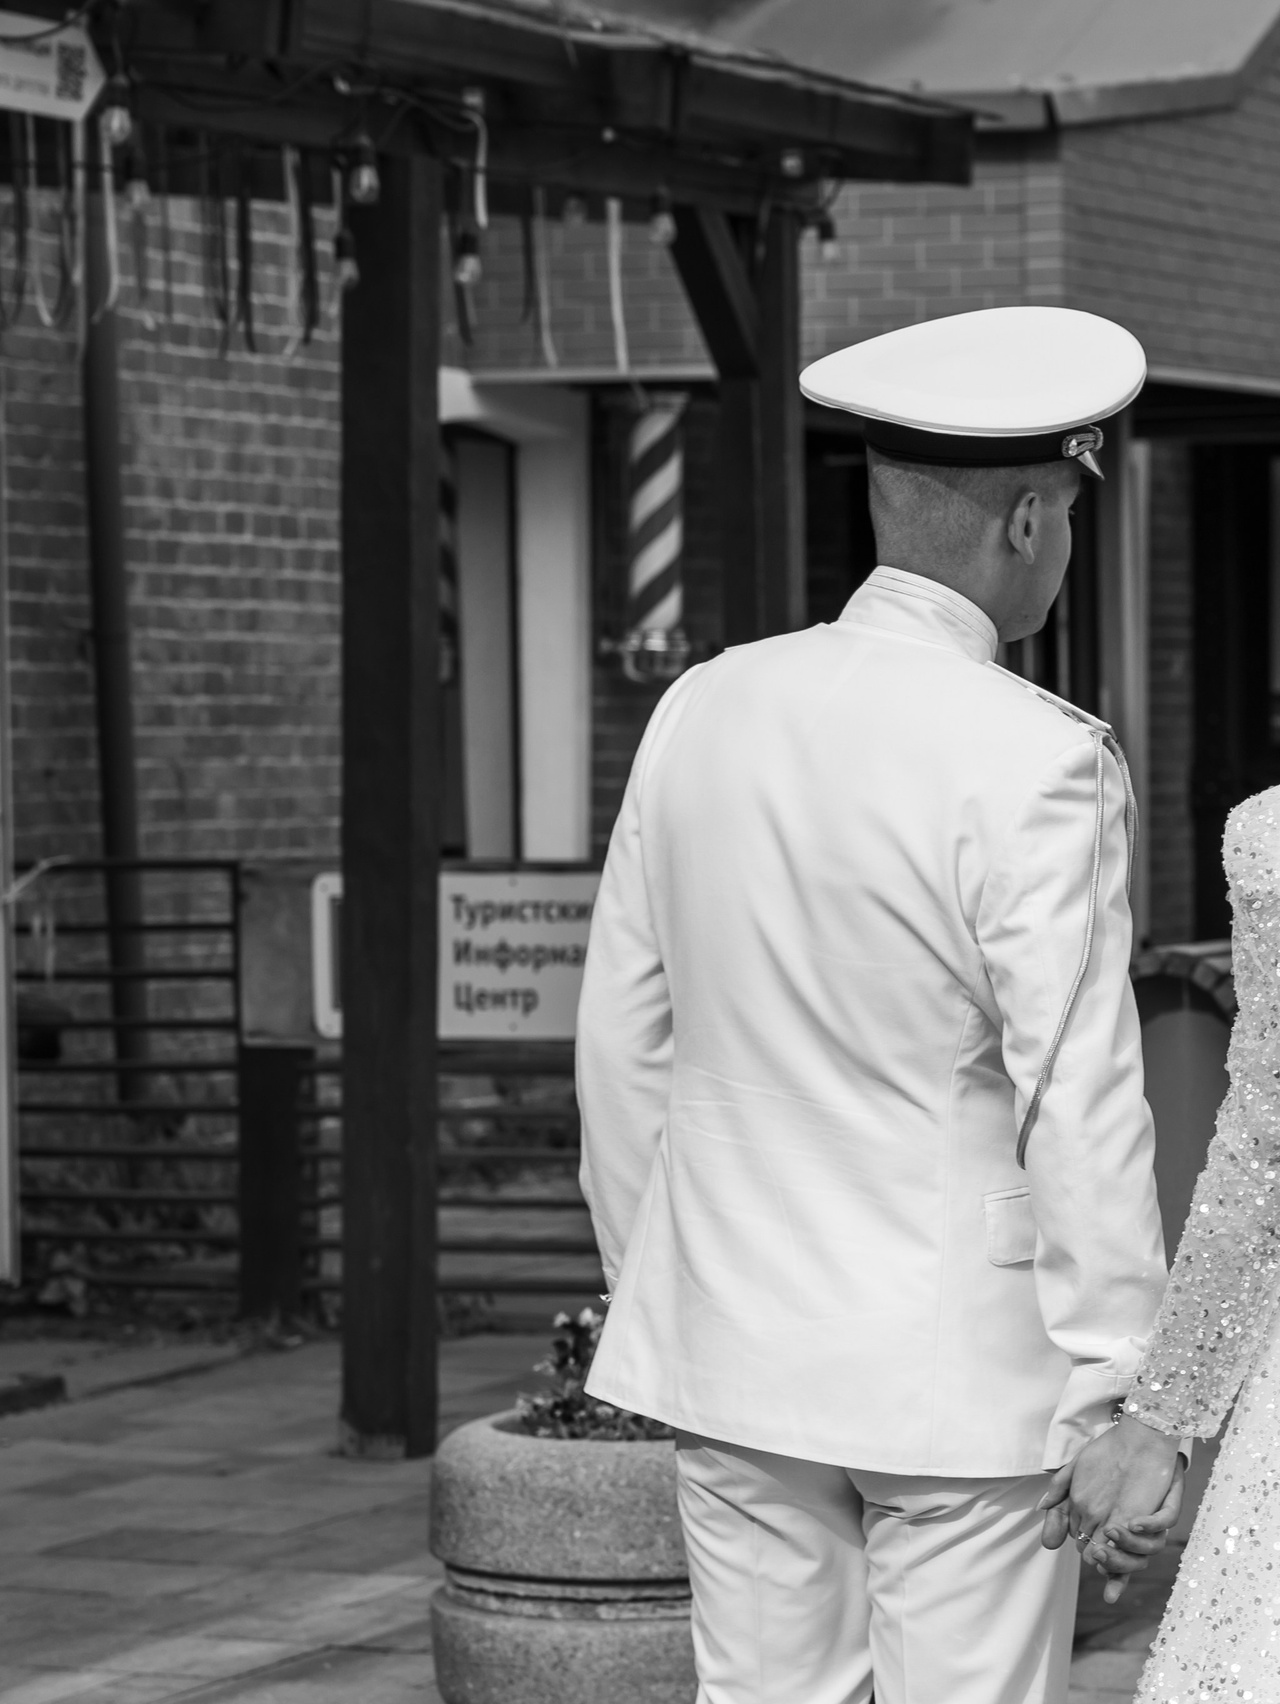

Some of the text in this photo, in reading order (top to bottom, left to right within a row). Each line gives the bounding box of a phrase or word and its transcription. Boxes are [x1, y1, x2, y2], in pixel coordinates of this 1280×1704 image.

[451, 893, 594, 930] Туристски
[453, 938, 587, 973] Информа
[453, 982, 540, 1017] Центр
